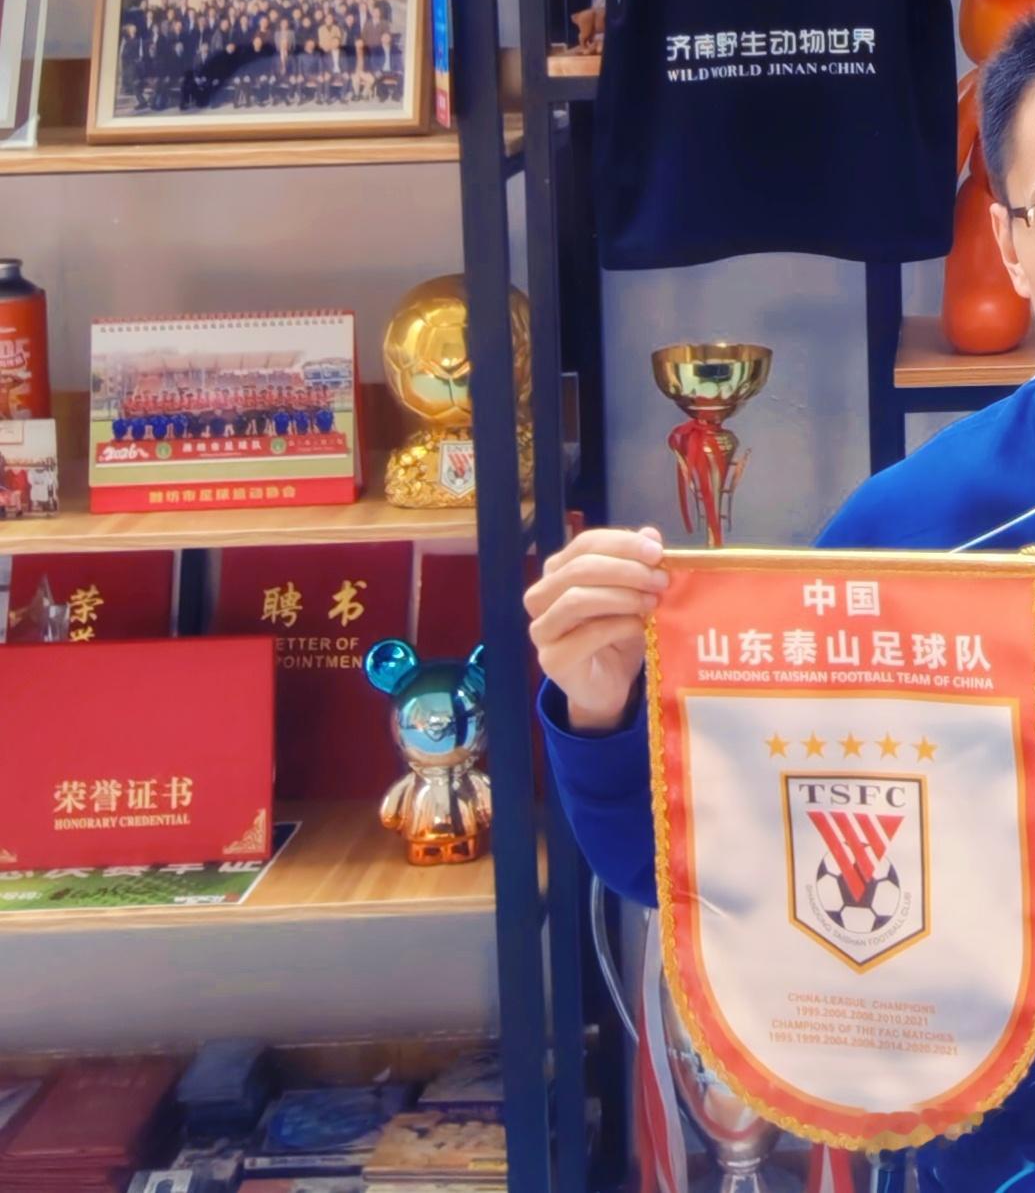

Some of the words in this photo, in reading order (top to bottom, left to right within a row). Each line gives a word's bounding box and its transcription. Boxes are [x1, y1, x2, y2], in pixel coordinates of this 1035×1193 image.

[666, 28, 875, 61] 济南野生动物世界
[667, 68, 709, 82] WILD
[711, 64, 762, 79] WORLD
[261, 580, 367, 627] 聘书
[803, 579, 880, 617] 中国
[276, 637, 331, 651] ETTER
[336, 637, 359, 651] OF
[697, 628, 991, 671] 山东泰山足球队
[698, 669, 770, 683] SHANDONG
[773, 670, 827, 684] TAISHAN
[831, 670, 894, 684] FOOTBALL
[897, 672, 931, 686] TEAM
[934, 674, 951, 686] OF
[953, 675, 994, 690] CHINA
[53, 776, 193, 814] 荣誉证书
[799, 783, 906, 808] TSFC
[54, 817, 118, 830] HONORARY
[119, 814, 191, 827] CREDENTIAL
[872, 1000, 936, 1014] CHAMPIONS
[772, 1019, 834, 1032] CHAMPIONS
[838, 1024, 853, 1033] OF
[855, 1024, 876, 1037] THE
